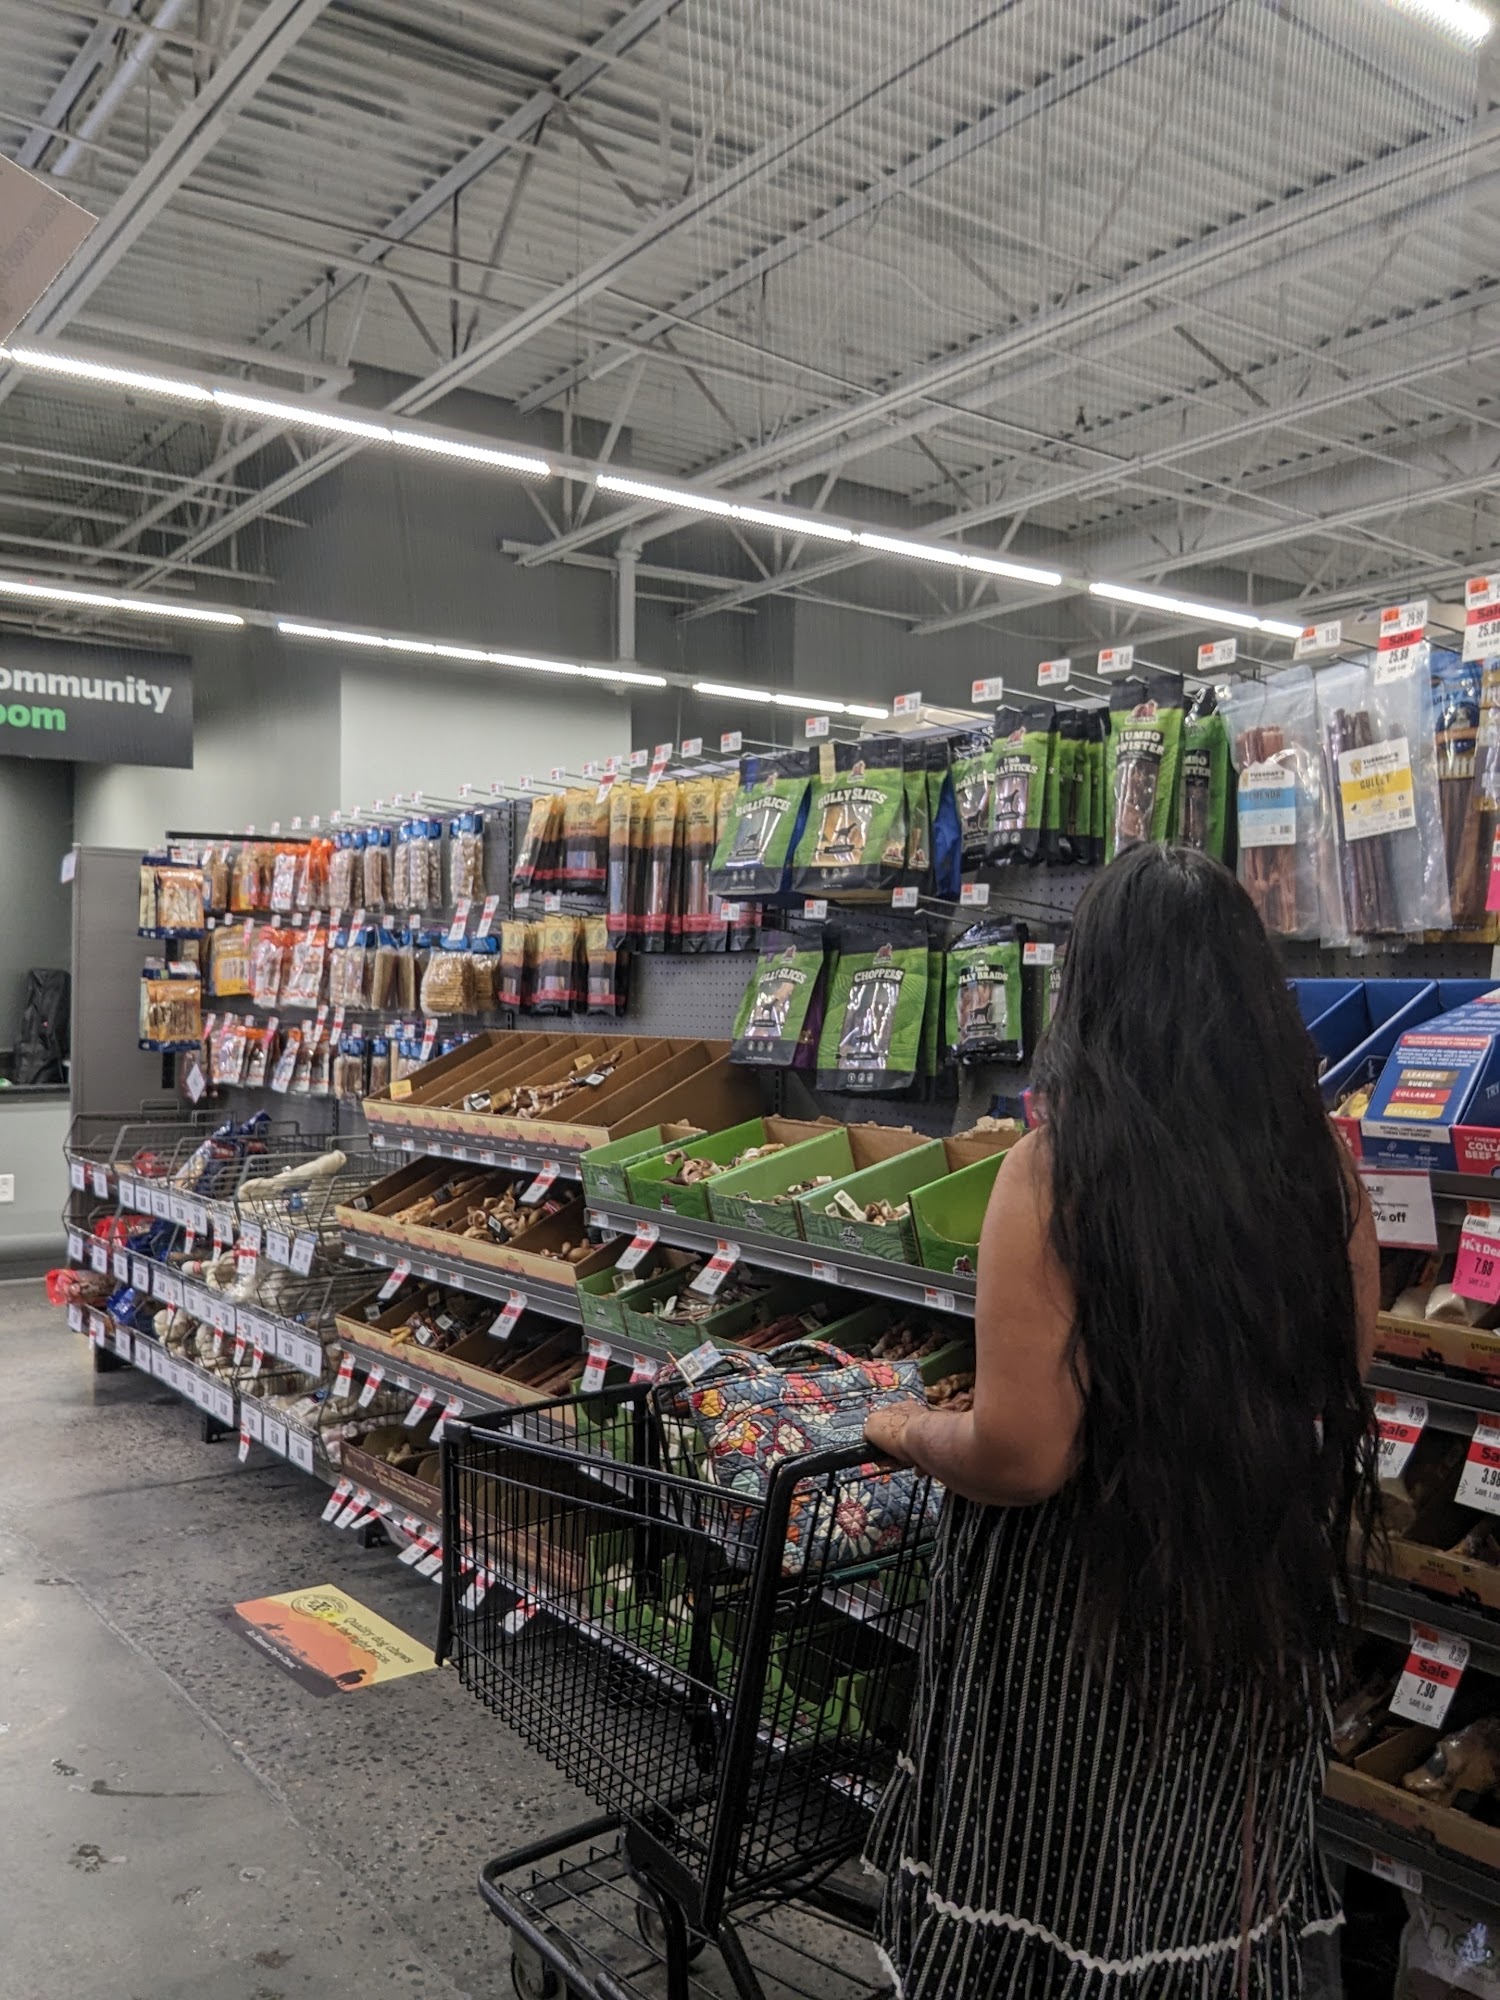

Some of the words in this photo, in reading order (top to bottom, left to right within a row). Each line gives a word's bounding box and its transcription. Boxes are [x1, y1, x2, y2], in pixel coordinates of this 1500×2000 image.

[0, 703, 66, 731] om
[854, 968, 904, 983] CHOPPERS
[1408, 1080, 1433, 1088] SUEDE
[1395, 1090, 1436, 1099] COLLAGEN
[1465, 1150, 1492, 1160] BEEF
[1389, 1211, 1406, 1223] off
[1461, 1238, 1482, 1253] Hot
[1419, 1659, 1449, 1680] Sale
[1416, 1679, 1438, 1700] 7.98
